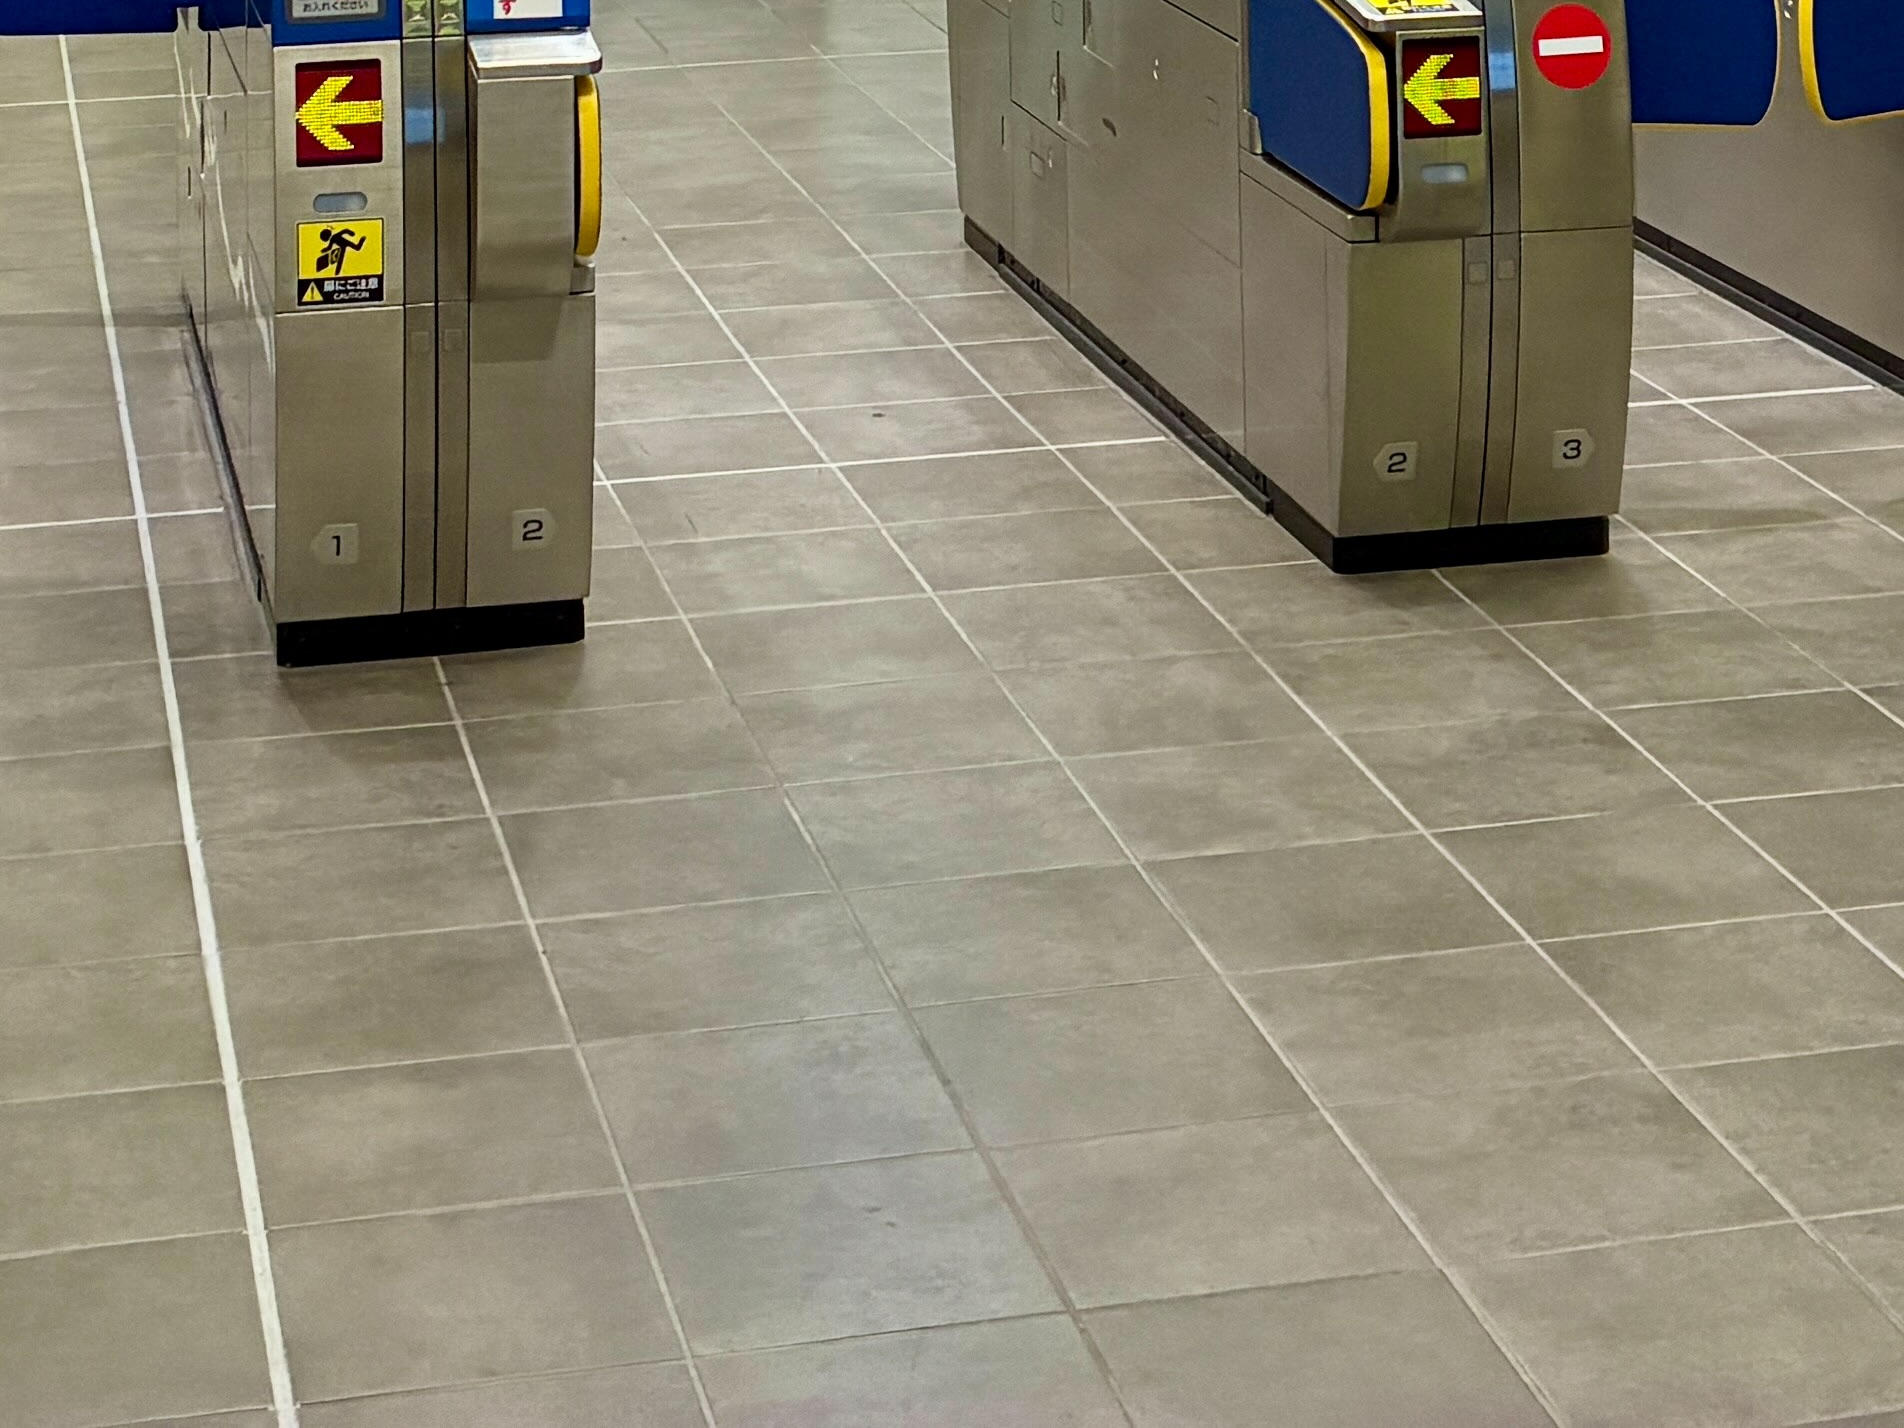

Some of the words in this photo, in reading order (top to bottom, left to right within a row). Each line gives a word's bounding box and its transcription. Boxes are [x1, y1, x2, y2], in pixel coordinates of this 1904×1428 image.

[303, 1, 369, 13] お入れください
[1562, 440, 1582, 460] 3
[1387, 453, 1408, 473] 2
[522, 520, 543, 540] 2
[331, 534, 342, 555] 1
